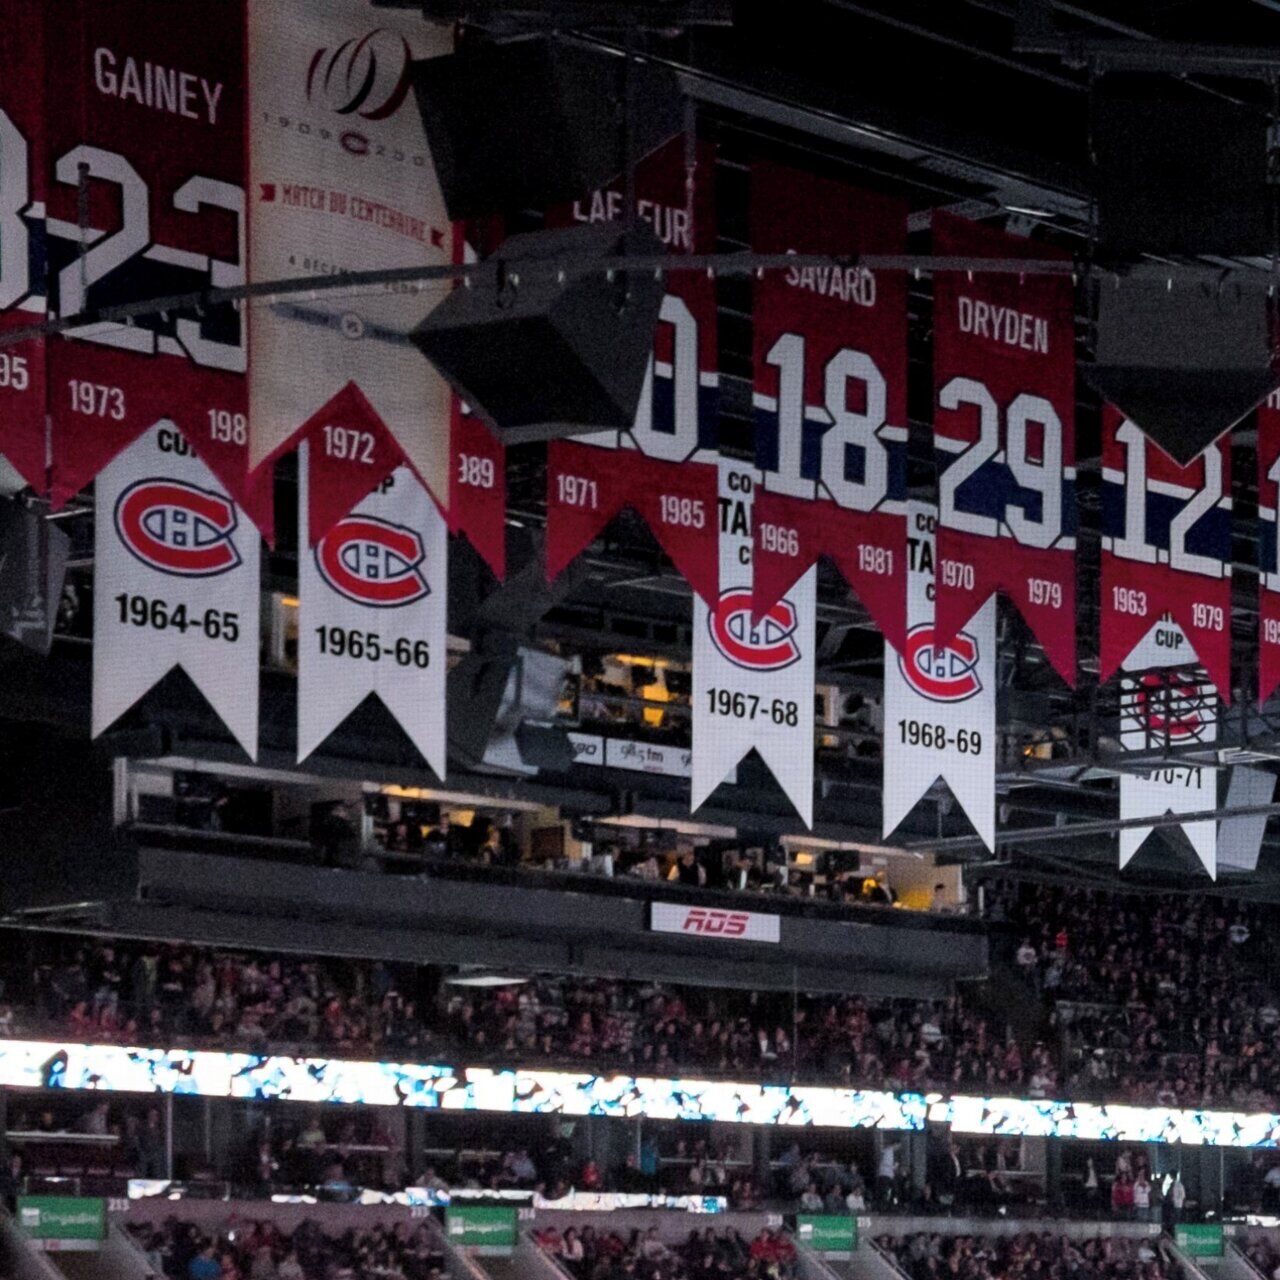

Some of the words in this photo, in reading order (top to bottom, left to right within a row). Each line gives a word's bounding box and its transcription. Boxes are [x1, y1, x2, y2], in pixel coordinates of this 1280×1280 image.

[94, 47, 224, 125] GAINEY
[784, 260, 877, 308] SAVARD
[958, 297, 1050, 355] DRYDEN
[69, 379, 126, 421] 1973
[767, 333, 888, 512] 18
[322, 426, 376, 464] 1972
[939, 377, 1062, 550] 29
[557, 474, 598, 509] 1971
[1116, 417, 1224, 578] 12
[659, 495, 705, 529] 1985
[759, 522, 799, 557] 1966
[858, 543, 894, 577] 1981
[940, 558, 976, 591] 1970
[1027, 577, 1064, 609] 1979
[1112, 585, 1148, 617] 1963
[114, 594, 240, 643] 1964-65
[1191, 601, 1225, 633] 1979
[315, 627, 431, 669] 1965-66
[1154, 628, 1184, 651] CUP
[707, 688, 799, 727] 1967-68
[898, 719, 982, 756] 1968-69
[682, 907, 750, 937] RDS
